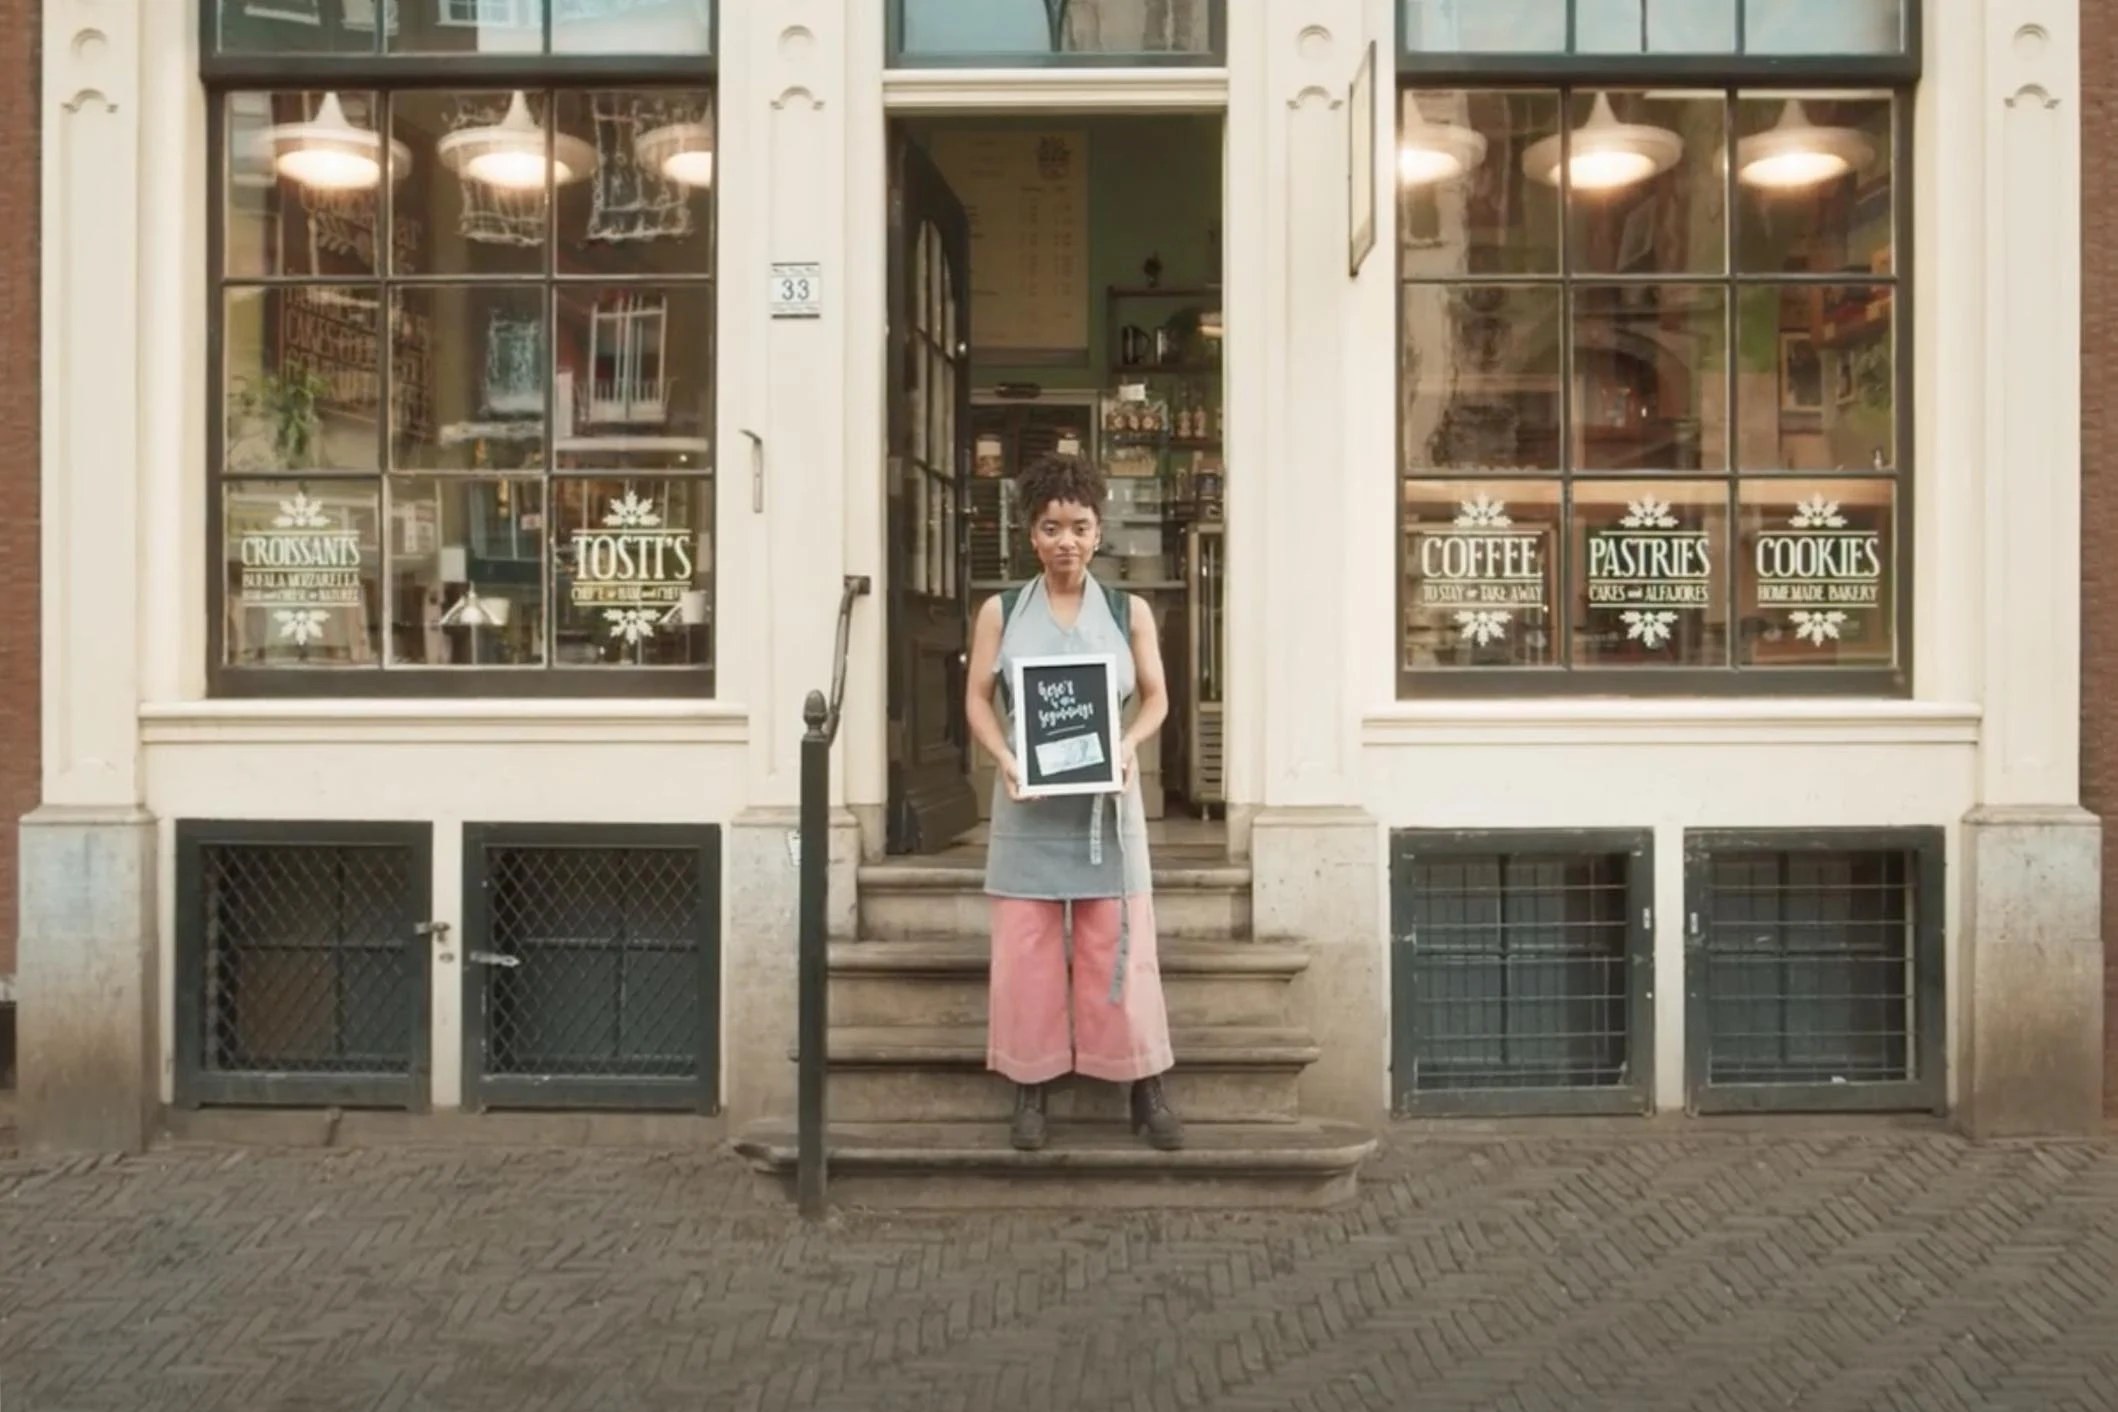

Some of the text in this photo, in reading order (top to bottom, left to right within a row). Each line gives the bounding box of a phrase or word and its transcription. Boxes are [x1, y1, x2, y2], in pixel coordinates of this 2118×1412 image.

[781, 278, 810, 300] 33
[241, 536, 361, 566] CROISSANTS
[571, 535, 692, 580] TOSTI'S
[1421, 536, 1544, 578] COFFEE
[1588, 537, 1711, 578] PASTRIES
[1755, 537, 1881, 578] COOKIES
[1423, 585, 1438, 601] TO
[1439, 585, 1464, 601] STAY
[1511, 585, 1543, 601] AWAY
[1589, 585, 1625, 602] CAKES
[1646, 585, 1709, 602] ALFAJORES
[1757, 585, 1879, 602] HOMEMADE BAKERY
